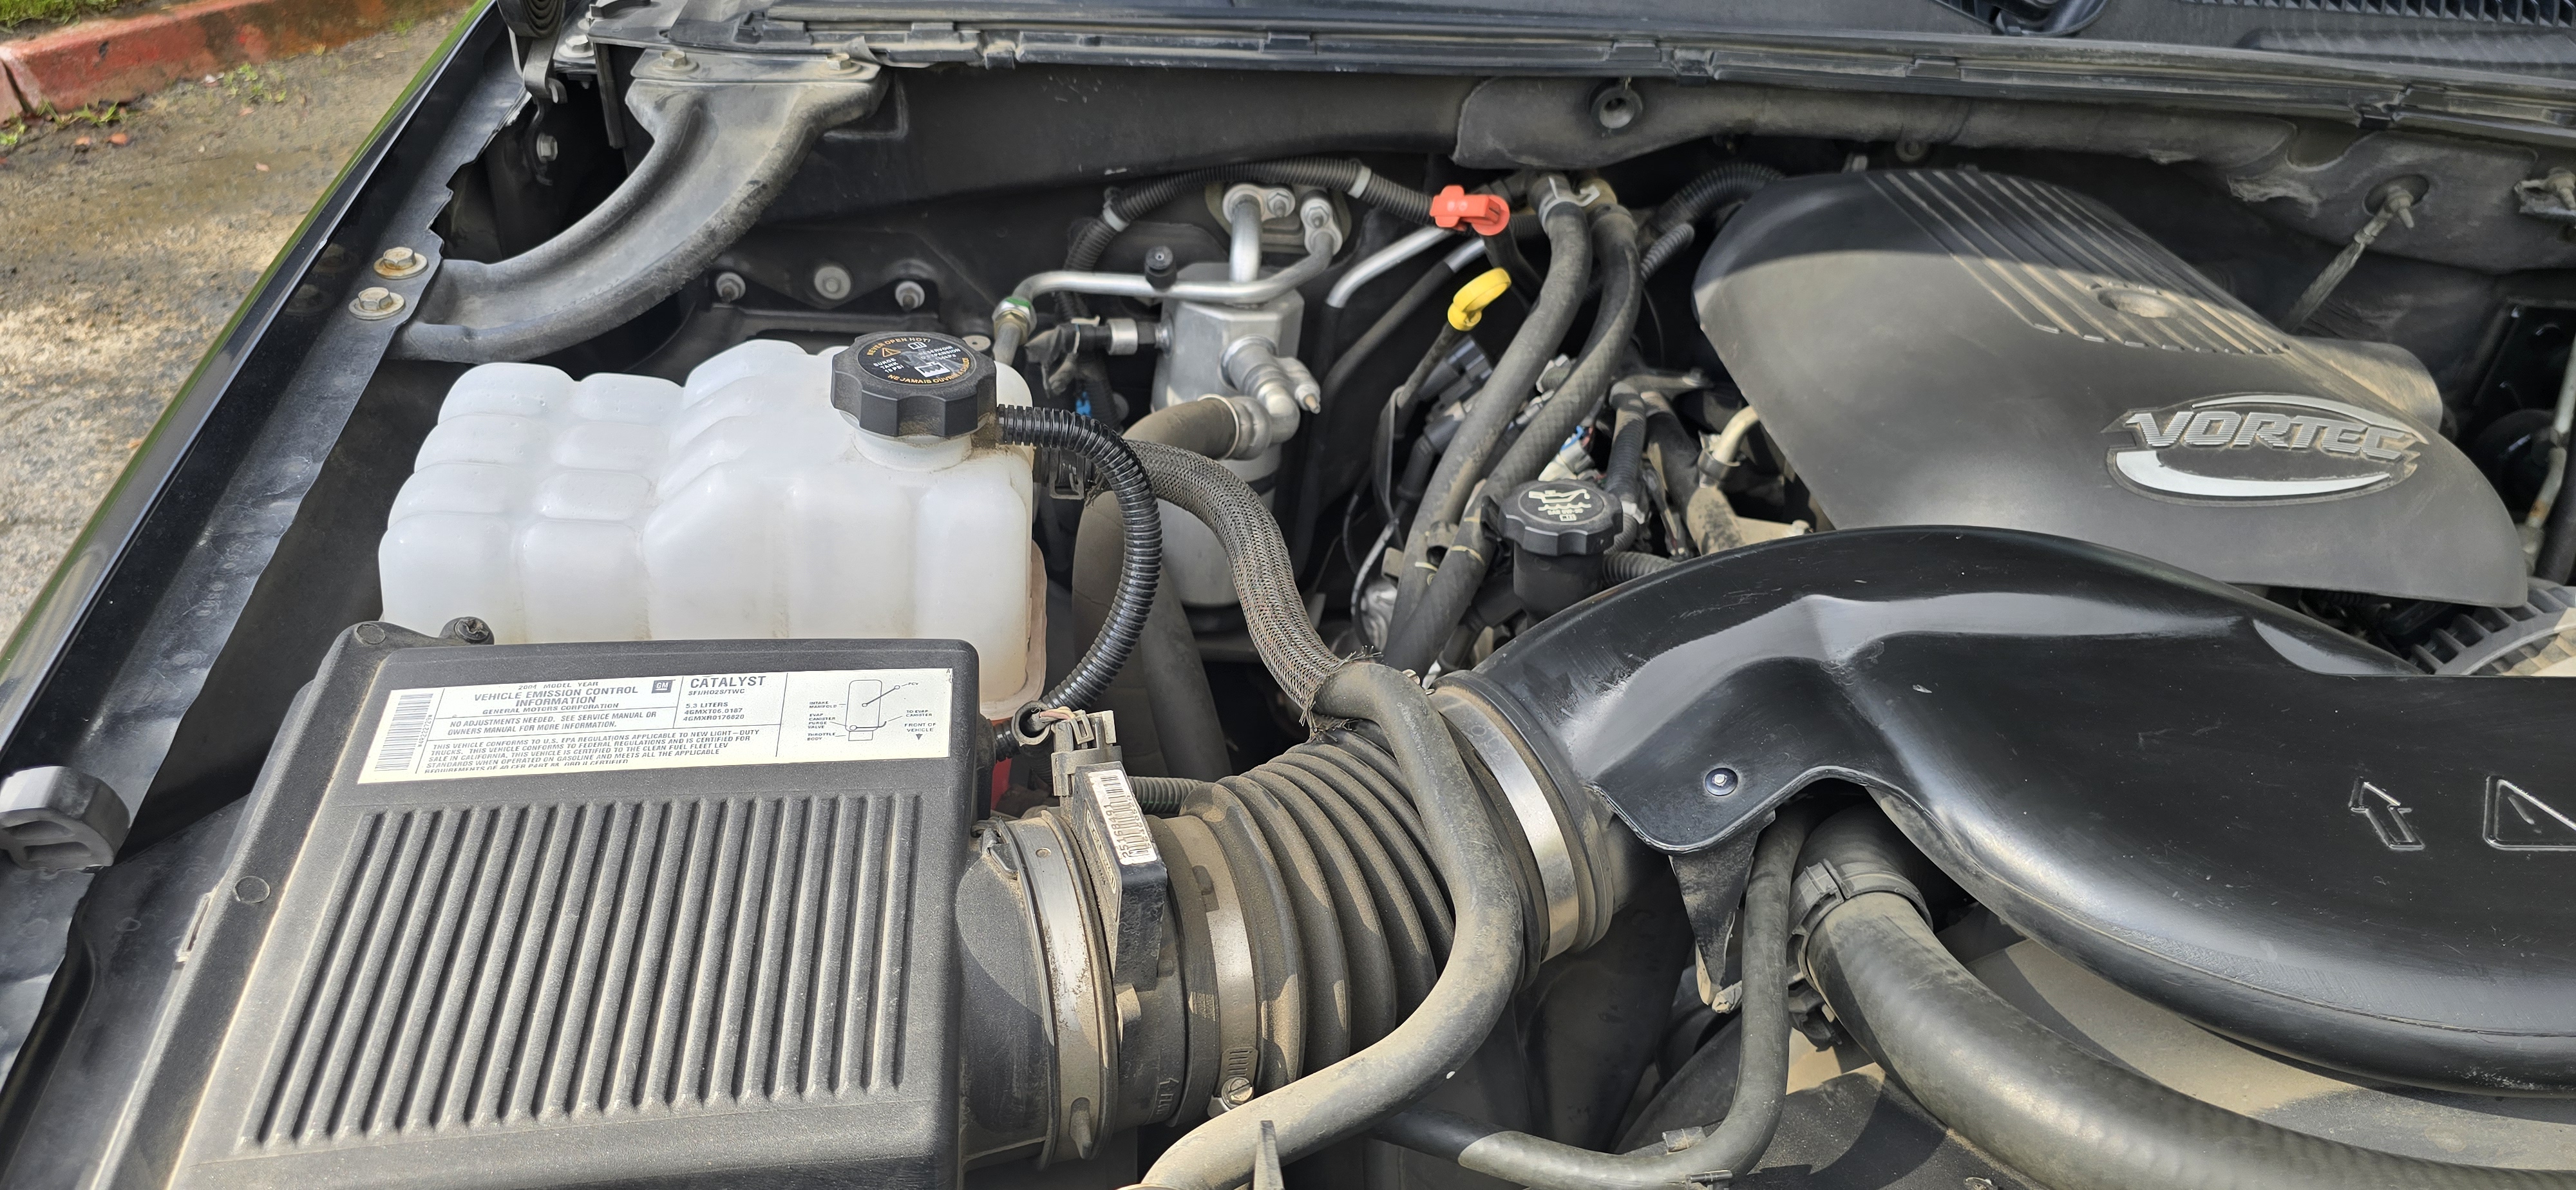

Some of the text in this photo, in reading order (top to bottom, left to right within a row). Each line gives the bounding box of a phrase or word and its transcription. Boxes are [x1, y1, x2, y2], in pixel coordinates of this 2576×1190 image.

[880, 361, 898, 370] TANK
[2125, 411, 2412, 461] VORTEC
[690, 676, 766, 688] CATALYST
[475, 686, 638, 701] VEHICLE EMISSION CONTROL
[516, 696, 596, 706] INFORMATION
[463, 718, 520, 726] ADJUSTMENTS
[1103, 803, 1129, 858] 25168491
